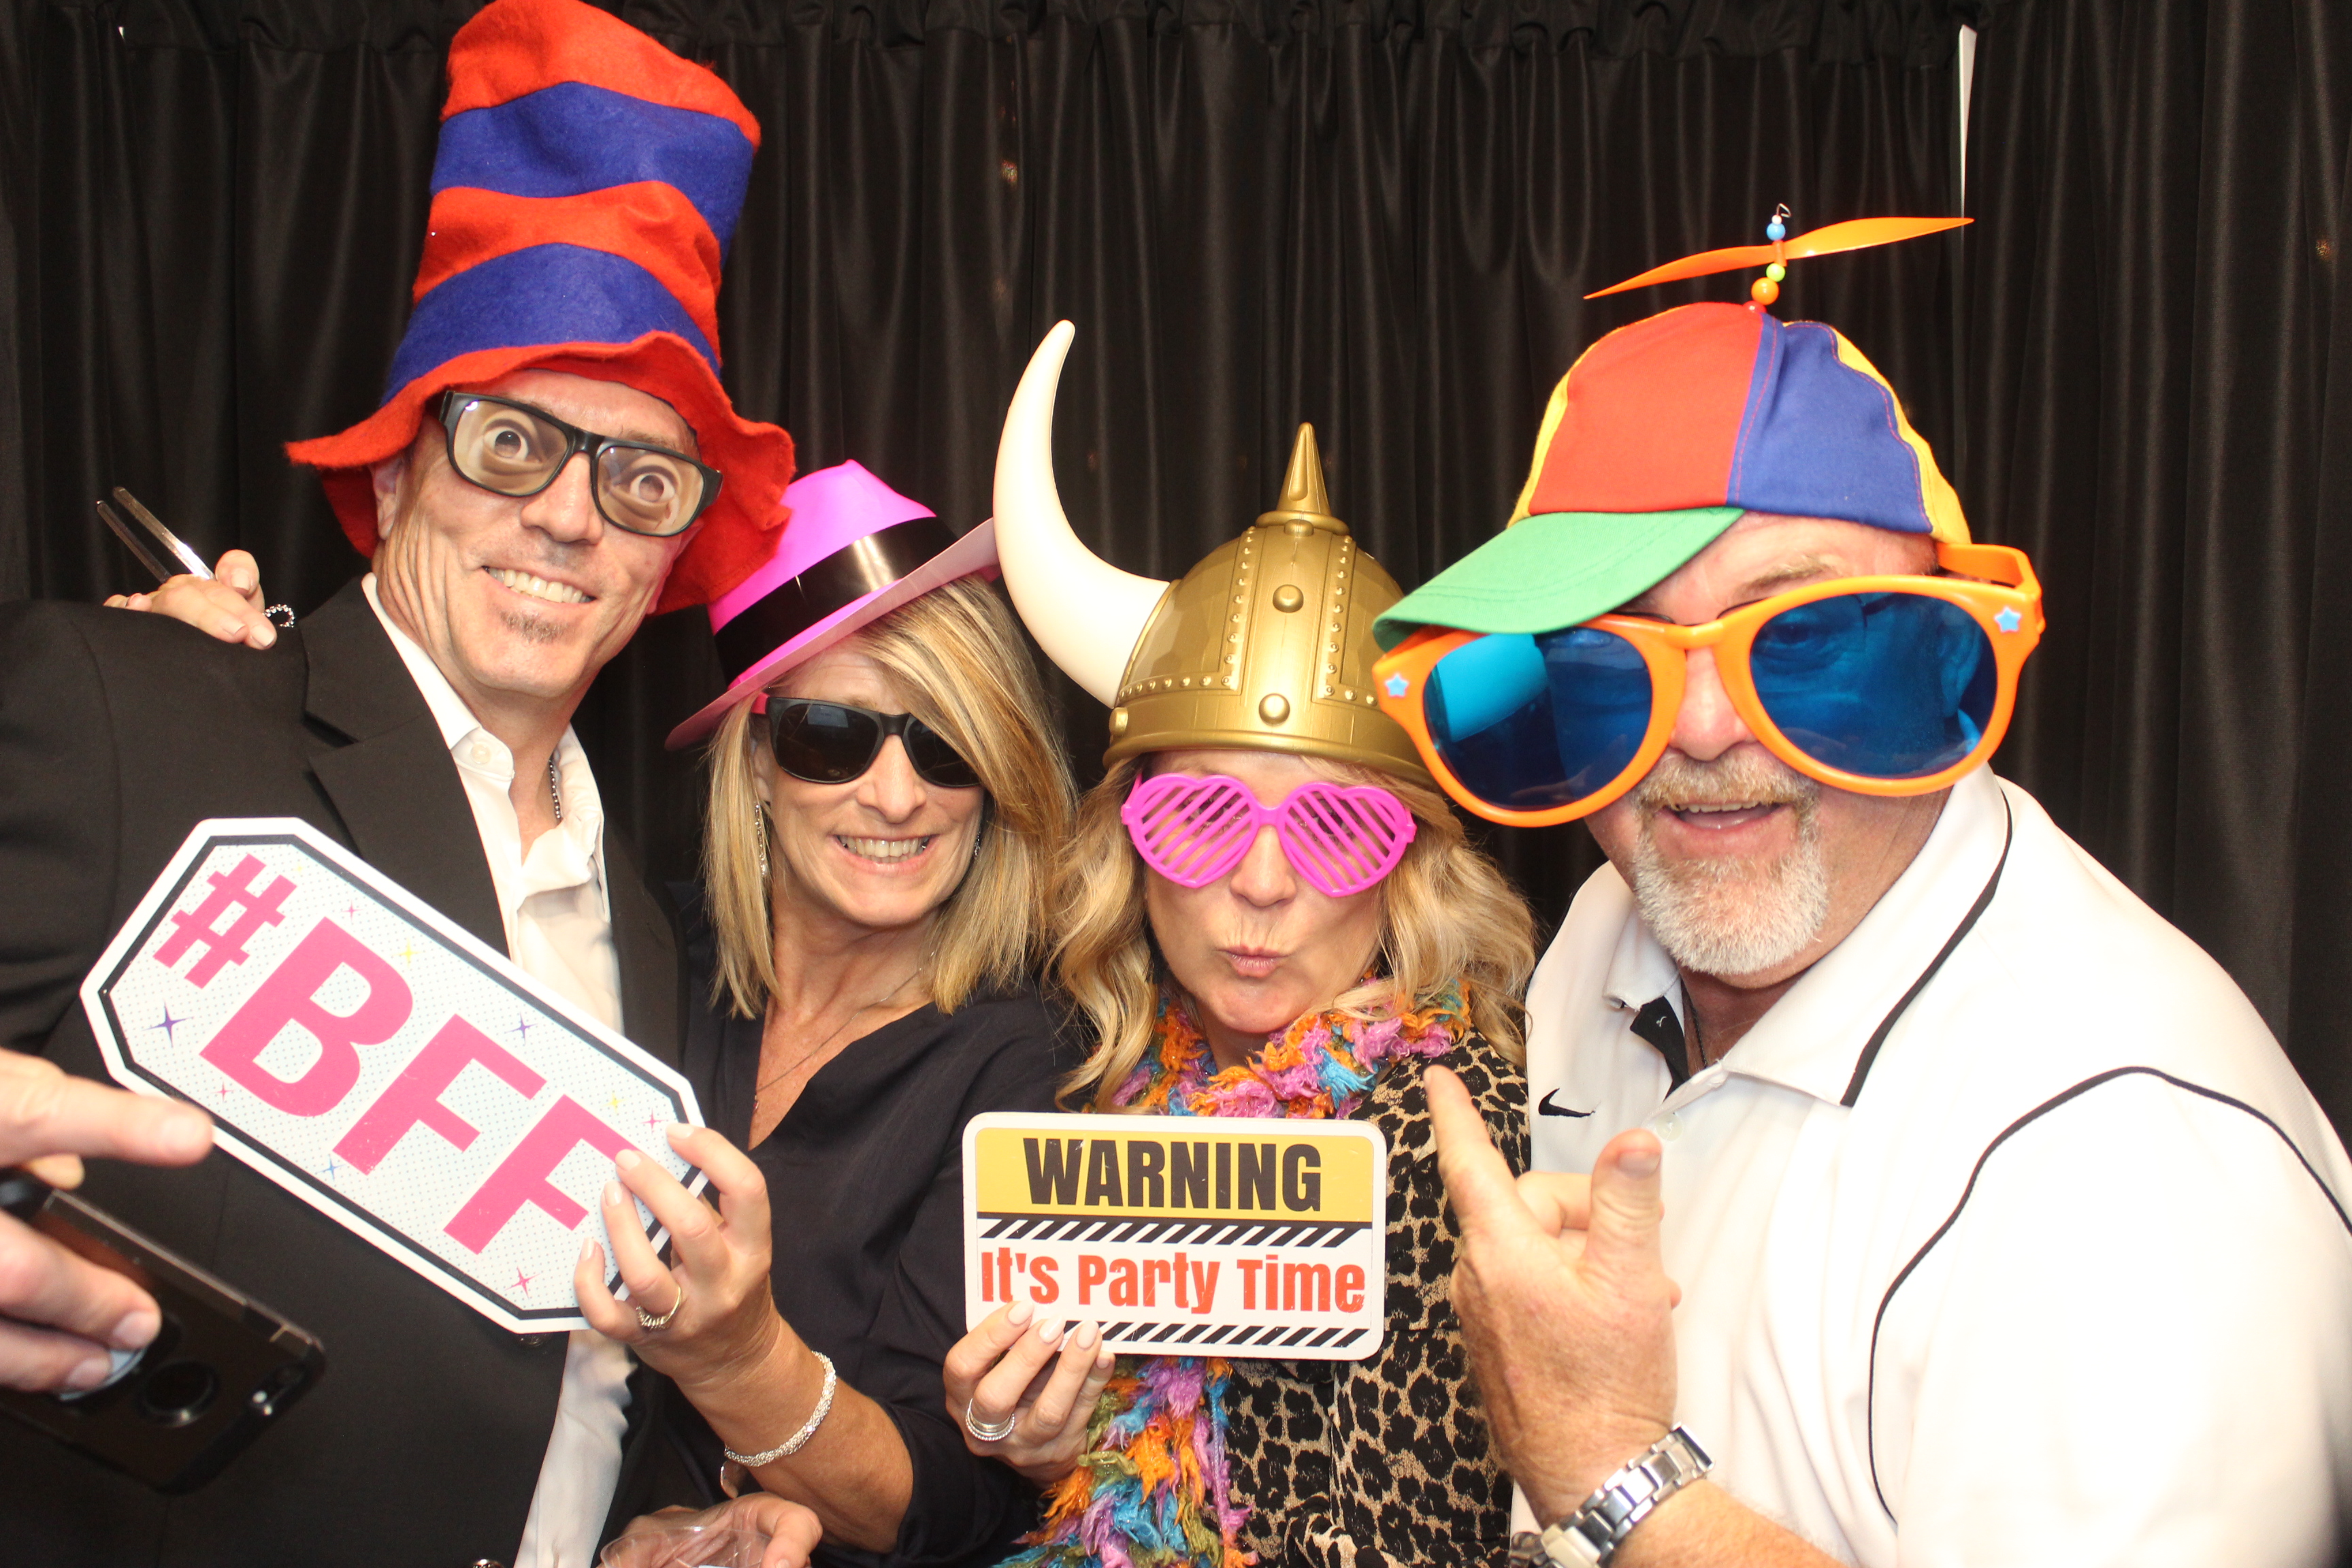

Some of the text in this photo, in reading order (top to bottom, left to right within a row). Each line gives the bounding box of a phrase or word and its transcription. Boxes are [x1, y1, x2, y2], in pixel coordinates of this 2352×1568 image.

[152, 853, 640, 1255] #BFF
[1023, 1137, 1321, 1212] WARNING
[981, 1247, 1365, 1315] It's Party Time
